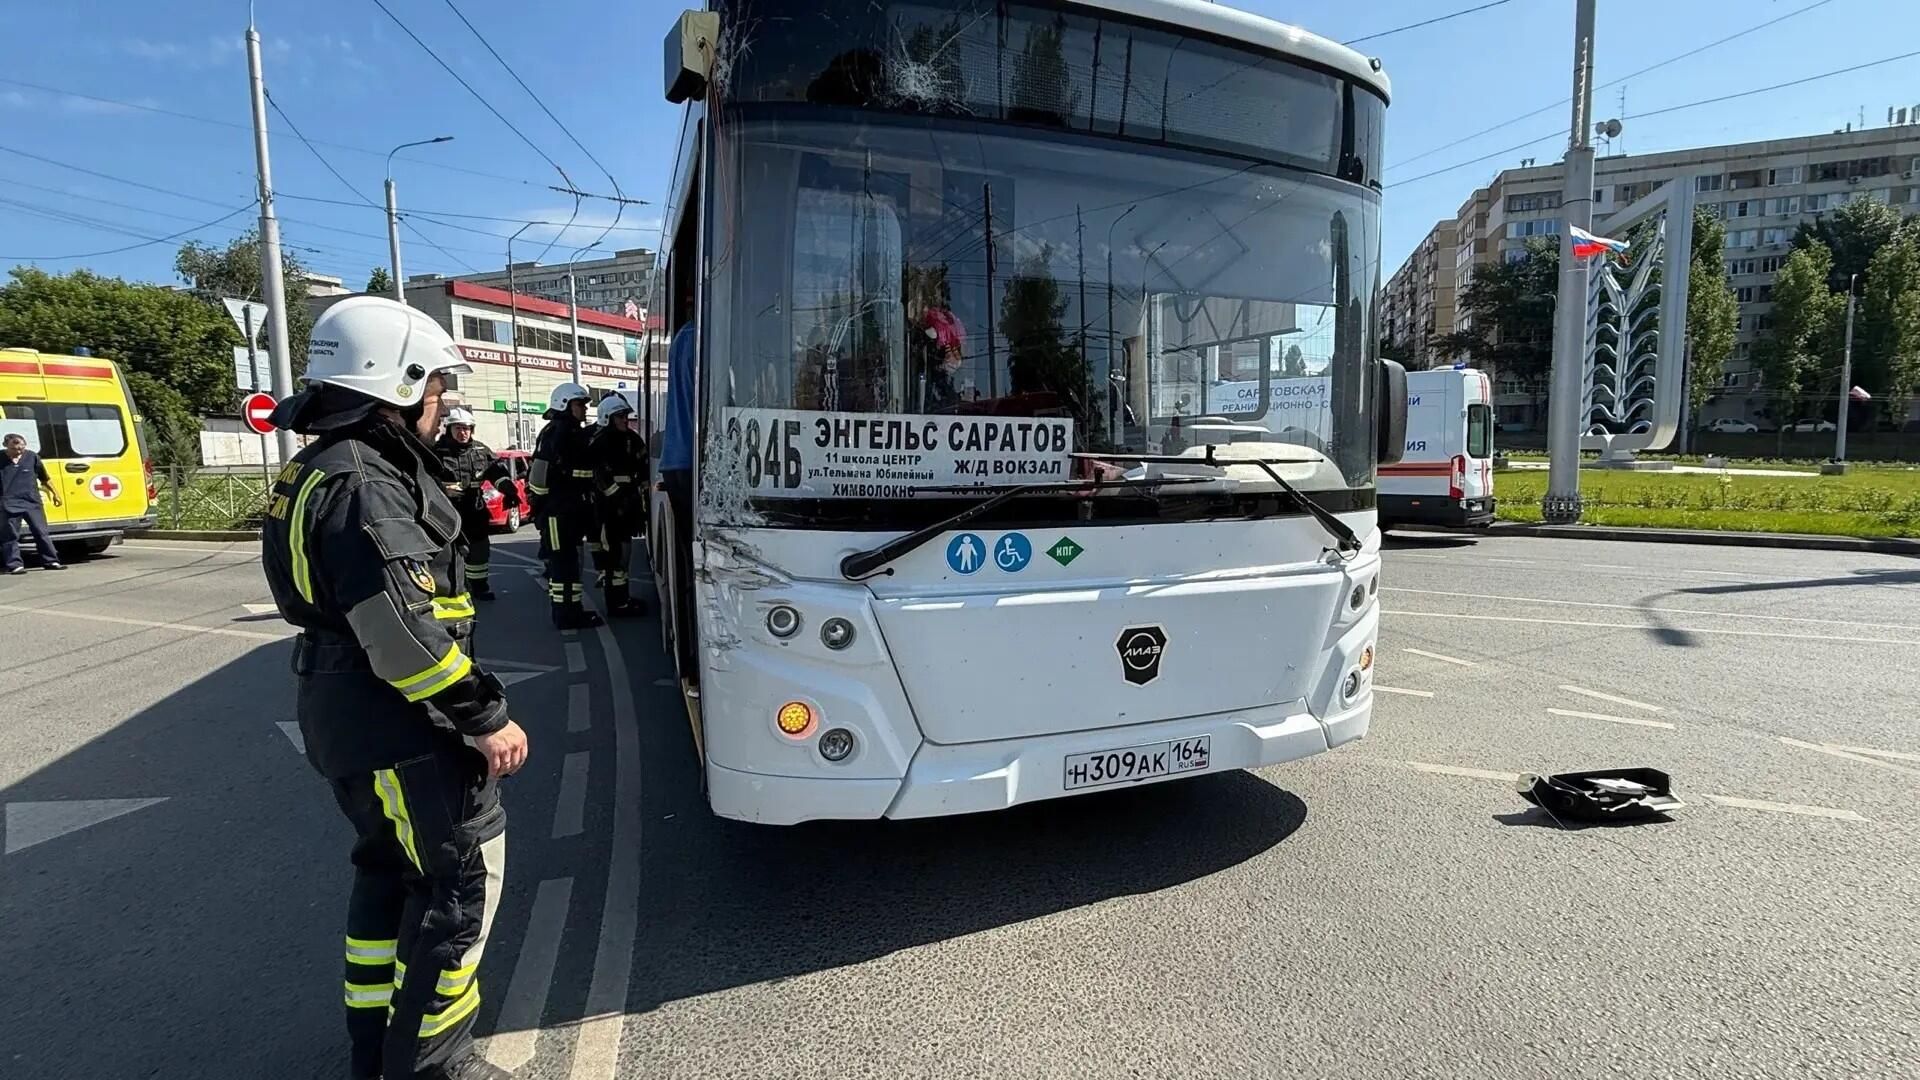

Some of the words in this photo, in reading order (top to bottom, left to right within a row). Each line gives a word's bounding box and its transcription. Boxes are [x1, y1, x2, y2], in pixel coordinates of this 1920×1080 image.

[465, 348, 500, 361] КУХНИ
[565, 361, 602, 375] СЛЬНИ
[1238, 385, 1325, 399] САРТОВСКАЯ
[1222, 400, 1312, 412] РЕАНИЦИОННО
[814, 418, 938, 450] ЭНГЕЛЬС
[948, 422, 1066, 452] САРАТОВ
[825, 452, 838, 463] 11
[842, 455, 879, 465] школа
[882, 454, 922, 467] ЦЕНТР
[875, 468, 934, 480] Юбилейный
[954, 460, 988, 476] Ж/Д
[993, 460, 1061, 474] ВОКЗАЛ
[832, 483, 915, 498] ХИМВОЛОКНО
[1056, 546, 1074, 556] КПГ
[1073, 751, 1166, 784] Н309АК
[1172, 739, 1208, 762] 164
[1178, 761, 1195, 769] RUS
